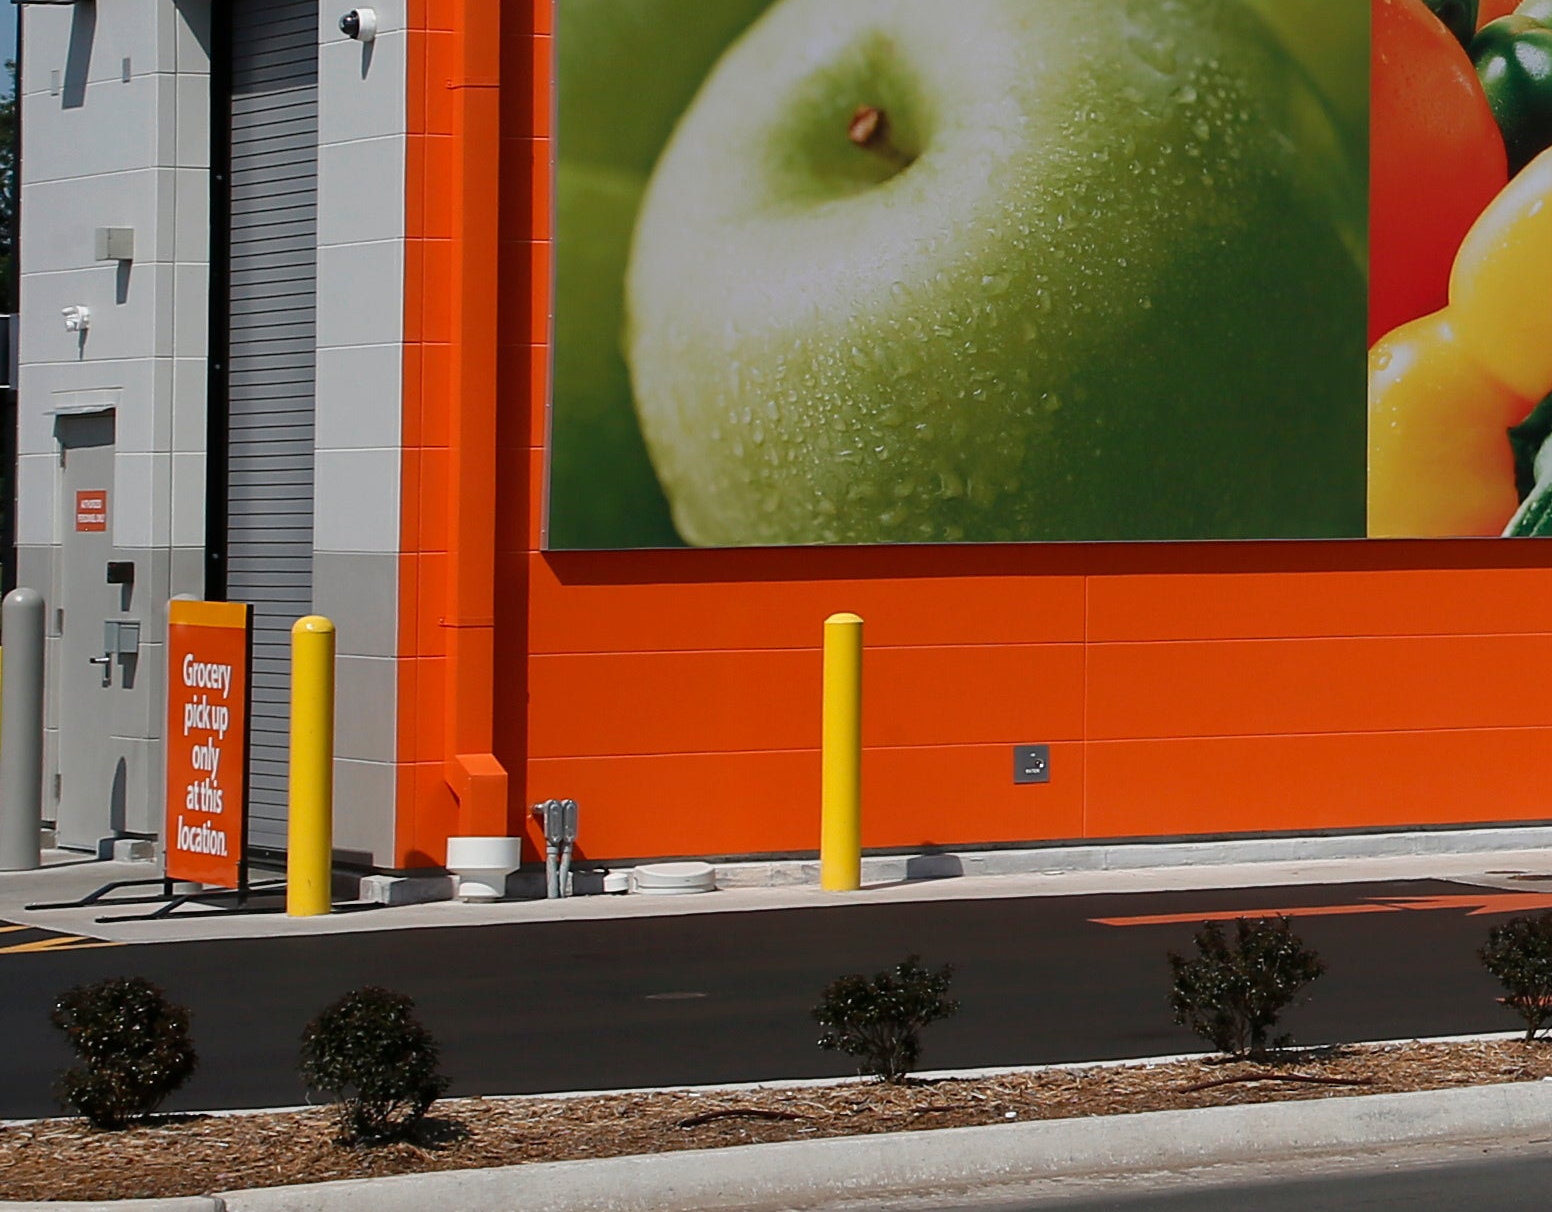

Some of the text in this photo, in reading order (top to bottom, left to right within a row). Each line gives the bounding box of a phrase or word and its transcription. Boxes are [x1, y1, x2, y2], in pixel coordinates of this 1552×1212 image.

[182, 653, 232, 699] Grocery
[184, 694, 229, 740] pick up
[191, 737, 220, 781] only
[186, 778, 223, 814] at this
[177, 815, 228, 857] location.
